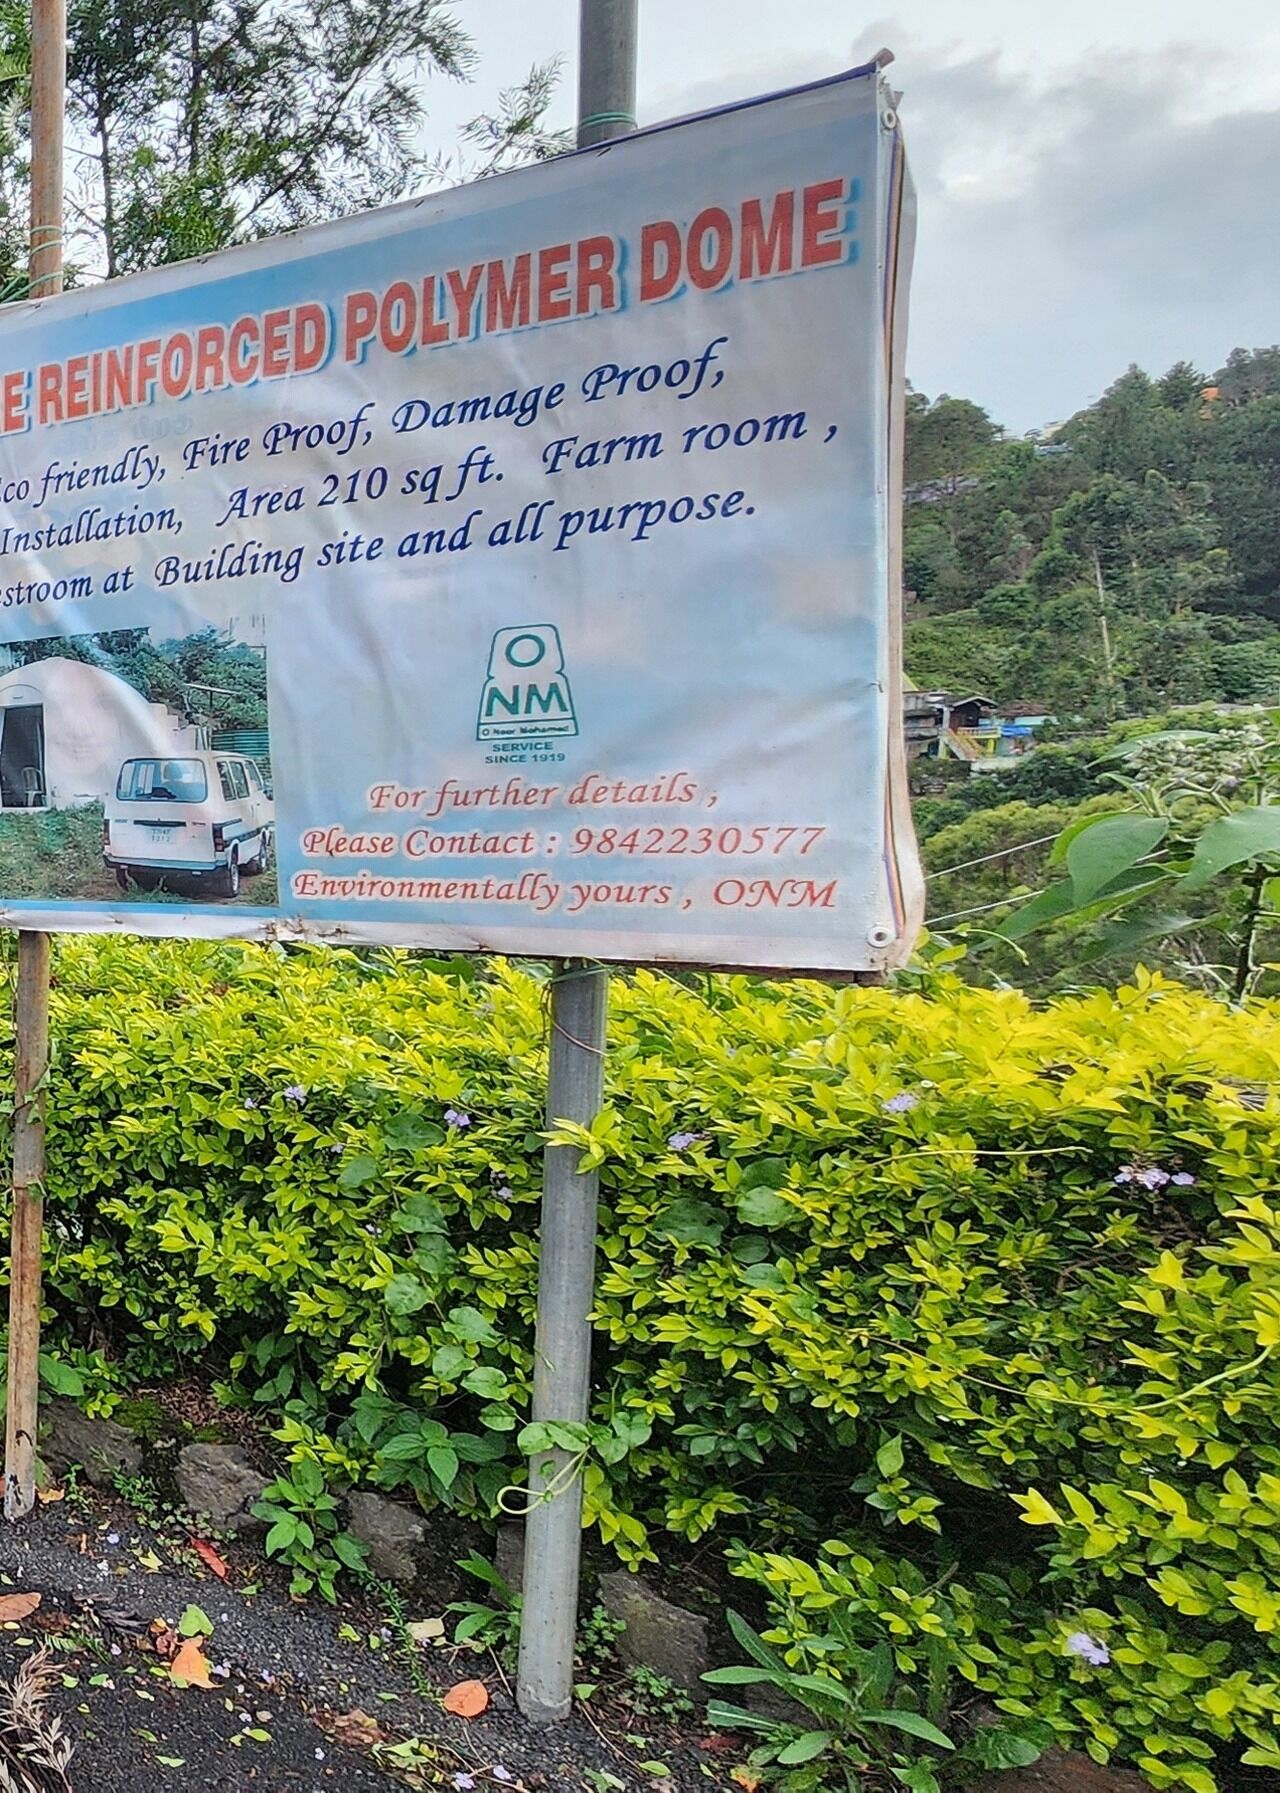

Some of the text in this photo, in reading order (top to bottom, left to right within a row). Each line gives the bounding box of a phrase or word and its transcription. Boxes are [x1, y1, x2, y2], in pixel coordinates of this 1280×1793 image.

[39, 304, 326, 426] REINFORCED
[345, 236, 617, 363] POLYMER
[640, 179, 846, 303] DOME
[32, 444, 167, 509] friendly,
[182, 432, 250, 472] Fire
[262, 402, 376, 457] Proof,
[391, 385, 566, 436] Damage
[581, 337, 729, 402] Proof,
[0, 504, 184, 558] Installation,
[215, 485, 304, 528] Area
[317, 465, 389, 508] 210
[401, 464, 442, 505] sq
[445, 446, 504, 501] ft.
[542, 430, 664, 476] Farm
[681, 409, 808, 456] room
[103, 564, 135, 594] at
[154, 540, 304, 584] Building
[316, 530, 383, 567] site
[397, 510, 483, 556] and
[487, 501, 554, 549] all
[552, 490, 757, 553] purpose.
[485, 682, 568, 717] NM
[484, 752, 566, 764] SINCE 1919
[492, 741, 554, 752] SERVICE
[370, 784, 426, 808] For
[426, 778, 558, 816] further
[568, 772, 697, 805] details
[303, 827, 393, 855] Please
[406, 829, 534, 856] Contact
[572, 827, 826, 854] 9842230577
[294, 873, 559, 910] Environmentally
[567, 883, 672, 911] yours
[712, 879, 839, 907] ONM
